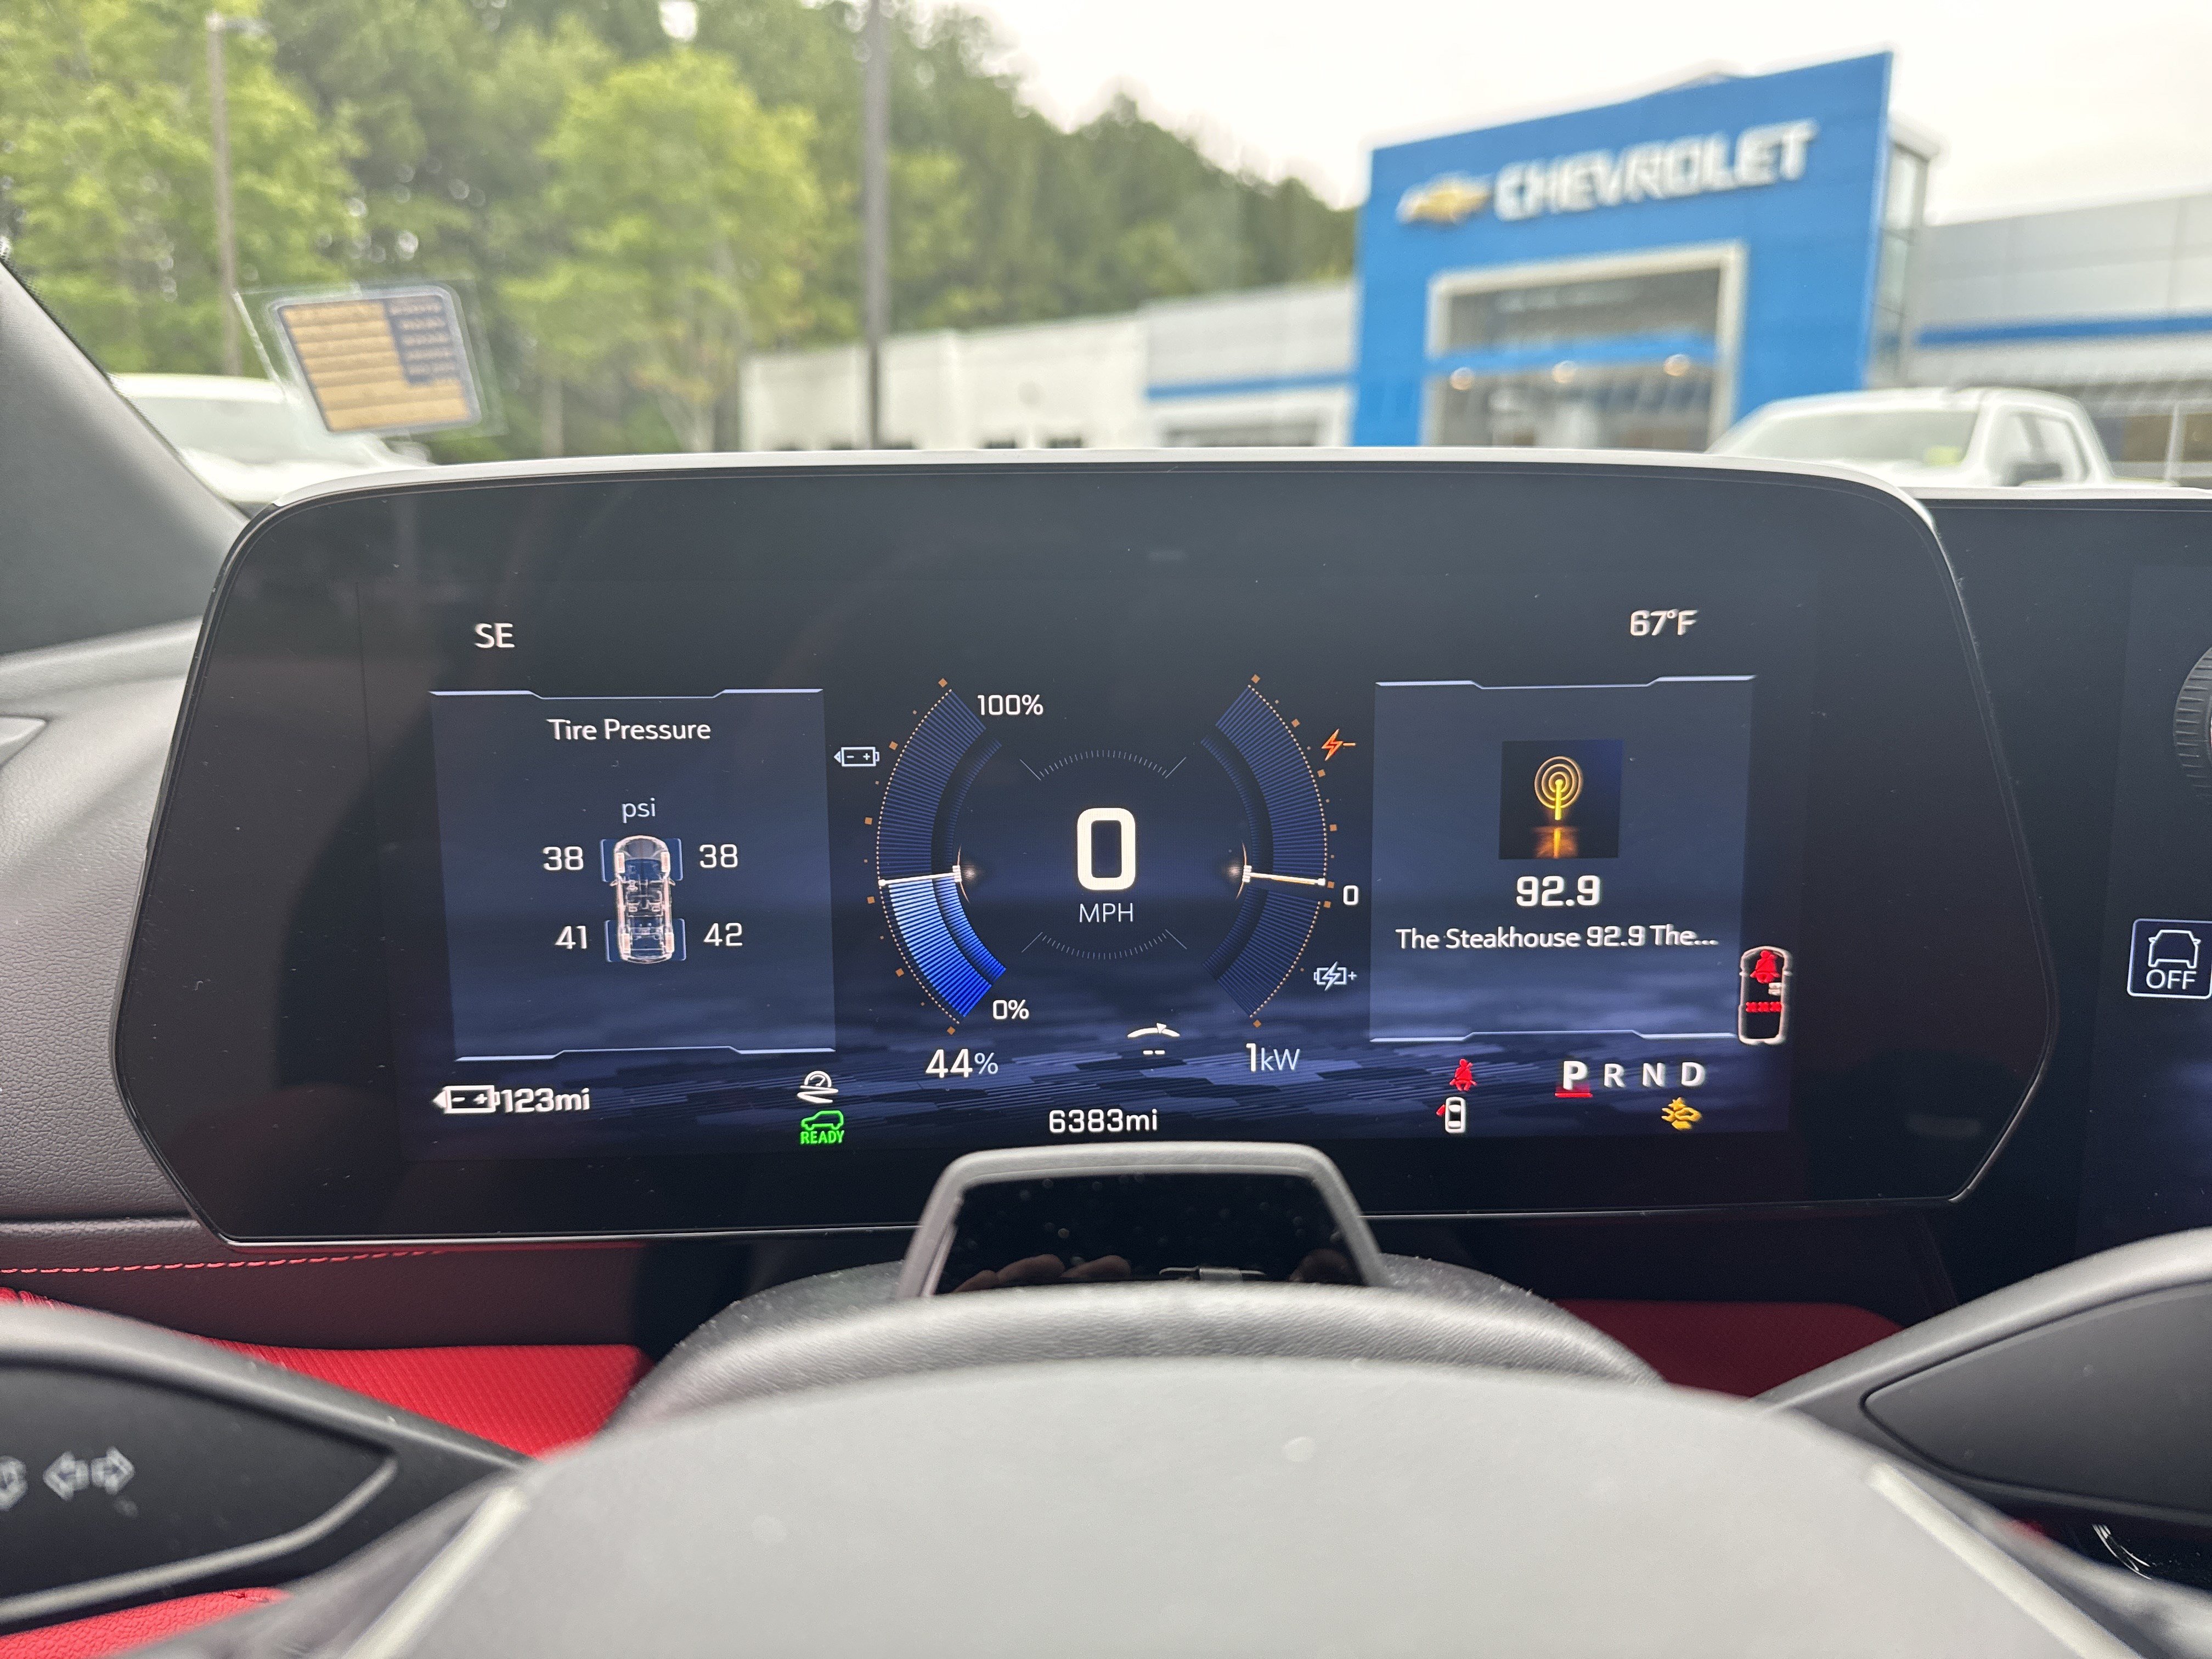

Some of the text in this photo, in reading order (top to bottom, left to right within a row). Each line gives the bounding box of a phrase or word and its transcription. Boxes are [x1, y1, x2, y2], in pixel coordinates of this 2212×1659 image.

[1494, 119, 1817, 221] CHEVROLET
[474, 623, 515, 648] SE
[977, 694, 1044, 715] 100%
[546, 719, 711, 740] Tire Pressure
[622, 797, 656, 823] psi
[542, 846, 584, 871] 38
[699, 844, 738, 868] 38
[1076, 808, 1136, 890] 0
[1342, 885, 1359, 906] 0
[1516, 875, 1601, 907] 92.9
[1079, 902, 1134, 923] MPH
[554, 925, 588, 949] 41
[703, 922, 743, 946] 42
[1395, 928, 1440, 949] The
[1445, 926, 1581, 949] Steakhouse
[1586, 925, 1646, 947] 92.9
[2145, 969, 2197, 990] OFF
[992, 999, 1030, 1020] 0%
[1562, 1060, 1706, 1090] P R N D
[503, 1087, 590, 1114] 123mi
[1048, 1108, 1158, 1133] 6383mi
[800, 1130, 845, 1144] READY
